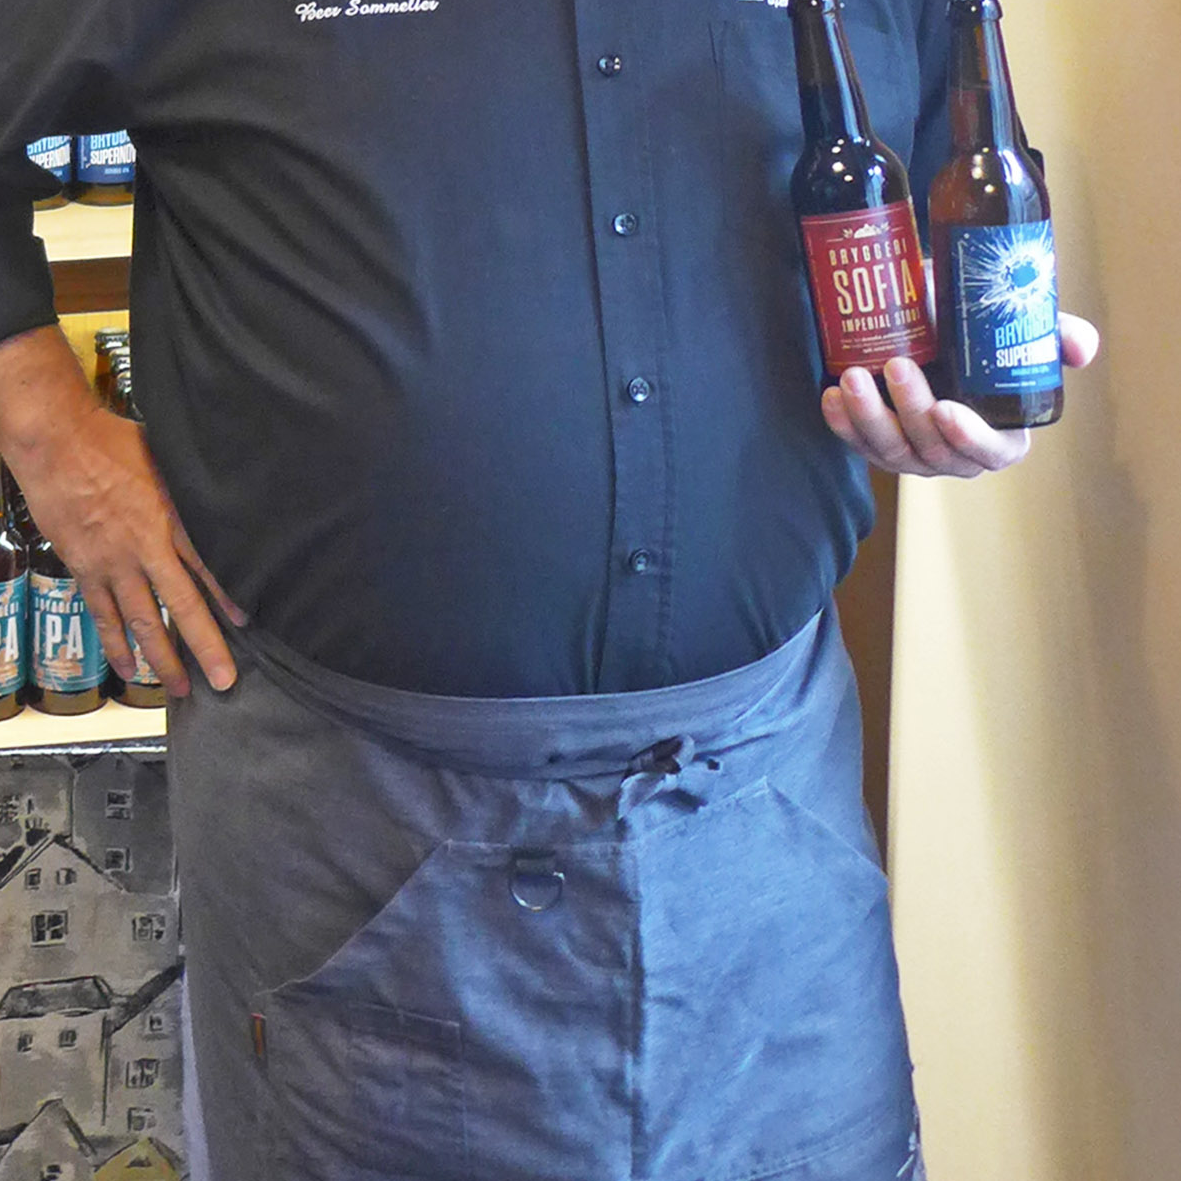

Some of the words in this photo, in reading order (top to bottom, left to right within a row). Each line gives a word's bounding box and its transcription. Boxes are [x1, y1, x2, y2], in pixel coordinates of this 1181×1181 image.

[295, 2, 342, 22] Beer
[829, 238, 907, 266] BRYGGERI
[833, 259, 917, 315] SOFIA
[842, 314, 891, 332] IMPERIAL
[34, 611, 84, 660] IPA
